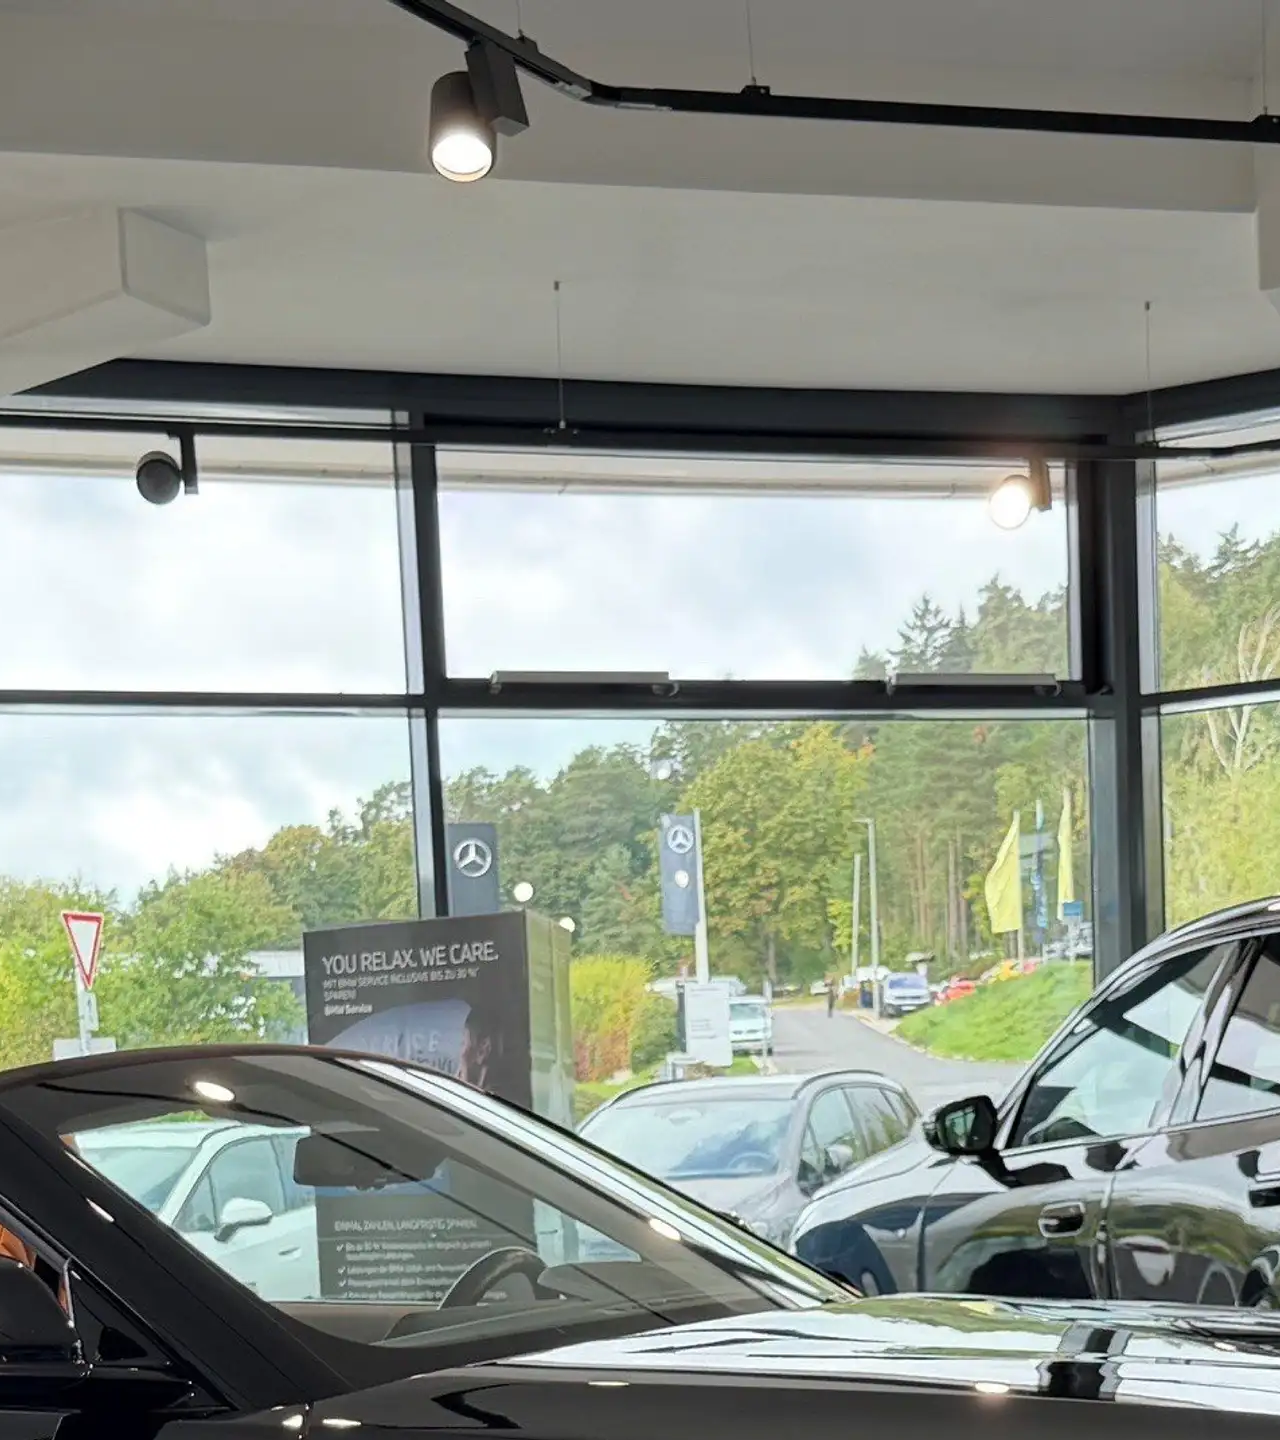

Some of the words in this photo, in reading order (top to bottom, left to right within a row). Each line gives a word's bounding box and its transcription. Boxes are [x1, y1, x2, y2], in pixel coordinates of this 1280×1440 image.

[322, 953, 358, 975] YOU
[360, 948, 418, 973] RELAX.
[419, 944, 448, 968] WE
[449, 940, 500, 965] CARE.
